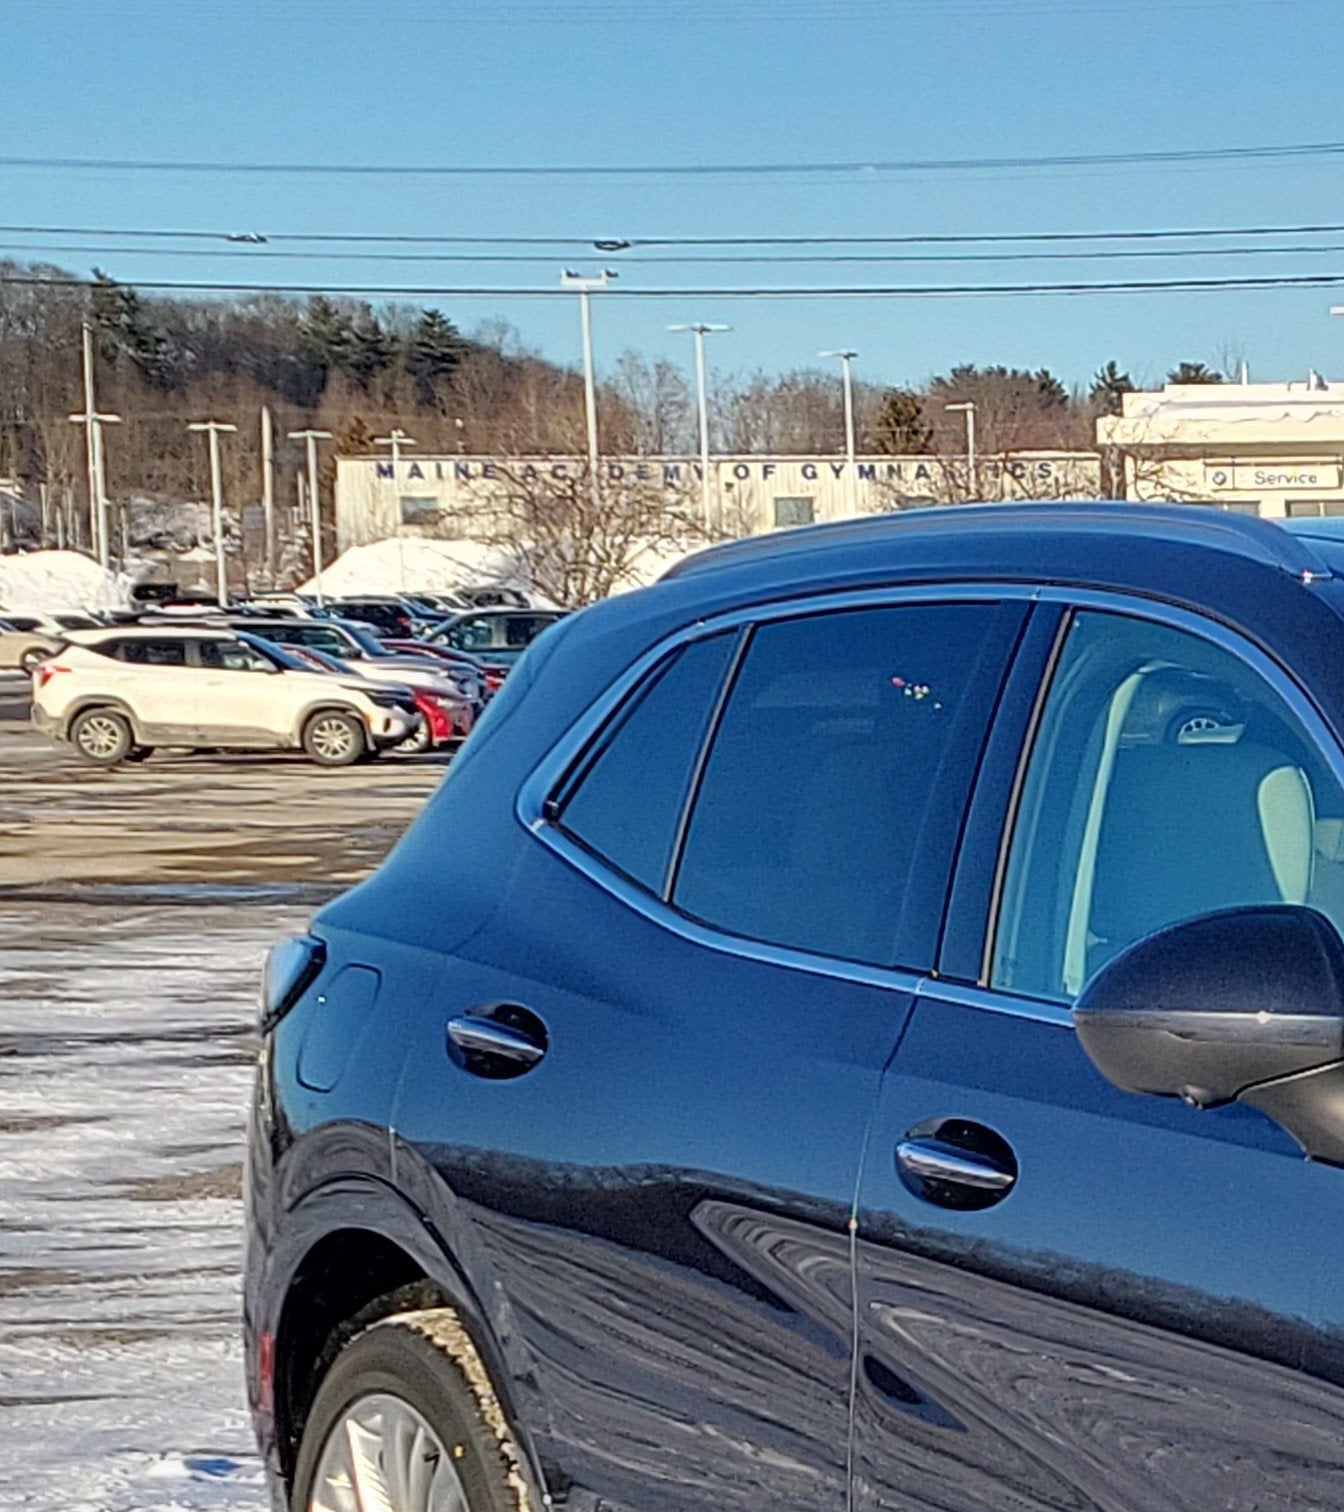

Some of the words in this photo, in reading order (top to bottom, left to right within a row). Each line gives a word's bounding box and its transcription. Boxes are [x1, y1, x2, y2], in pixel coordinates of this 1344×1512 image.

[376, 463, 498, 480] MAINE
[520, 463, 704, 481] ACDEMY
[732, 463, 776, 480] OF
[1254, 470, 1318, 485] Service
